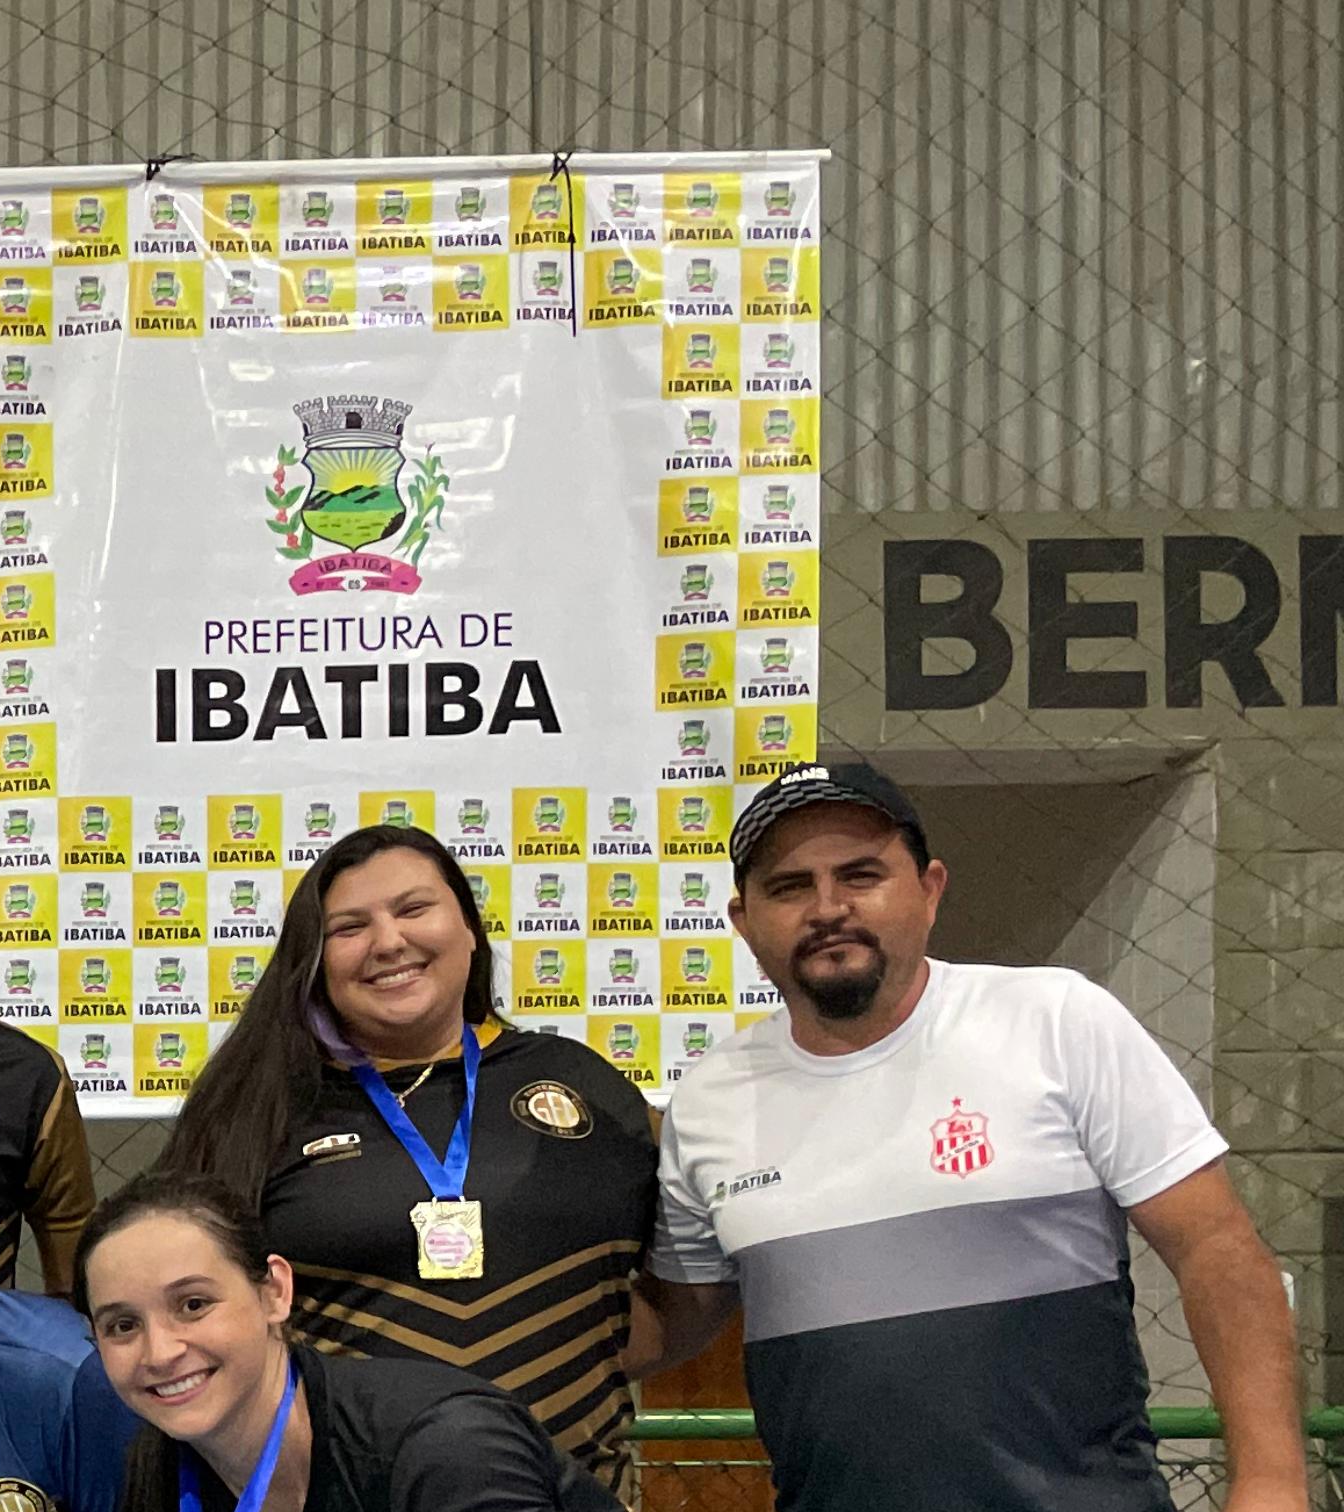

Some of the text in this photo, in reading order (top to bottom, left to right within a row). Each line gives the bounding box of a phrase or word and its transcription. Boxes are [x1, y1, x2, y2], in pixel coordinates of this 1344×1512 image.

[437, 232, 503, 249] IBATIBA
[590, 228, 657, 244] IBATIBA
[668, 226, 734, 242] IBATIBA
[746, 226, 812, 241] IBATIBA
[134, 239, 198, 254] IBATIBA
[209, 239, 273, 253] IBATIBA
[284, 237, 350, 252] IBATIBA
[361, 235, 427, 251] IBATIBA
[57, 243, 122, 259] IBATIBA
[438, 309, 504, 325] IBATIBA
[588, 304, 656, 322] IBATIBA
[746, 302, 813, 317] IBATIBA
[58, 317, 123, 338] IBATIBA
[135, 316, 198, 331] IBATIBA
[209, 314, 275, 330] IBATIBA
[285, 313, 350, 328] IBATIBA
[668, 379, 734, 393] IBATIBA
[745, 376, 813, 393] IBATIBA
[665, 455, 733, 472] IBATIBA
[745, 453, 813, 469] IBATIBA
[663, 532, 732, 550] IBATIBA
[744, 529, 813, 545] IBATIBA
[317, 557, 393, 575] IBATIBA
[662, 609, 730, 628] IBATIBA
[743, 605, 813, 623] IBATIBA
[204, 612, 513, 656] PREFEITURA DE
[660, 687, 728, 705] IBATIBA
[740, 682, 811, 700] IBATIBA
[155, 660, 563, 743] IBATIBA
[661, 764, 727, 781] IBATIBA
[447, 845, 506, 858] BATIBA
[517, 842, 581, 857] IBATIBA
[592, 842, 653, 856] IBATIBA
[663, 840, 727, 856] IBATIBA
[64, 851, 127, 865] IBATIBA
[138, 850, 202, 865] IBATIBA
[212, 849, 277, 864] IBATIBA
[517, 918, 581, 933] IBATIBA
[591, 917, 654, 932] IBATIBA
[664, 917, 727, 931] IBATIBA
[63, 927, 127, 942] IBATIBA
[138, 926, 202, 941] IBATIBA
[213, 925, 277, 940] IBATIBA
[517, 994, 581, 1009] IBATIBA
[592, 993, 654, 1008] IBATIBA
[665, 992, 728, 1007] IBATIBA
[64, 1003, 128, 1018] IBATIBA
[138, 1002, 202, 1016] IBATIBA
[72, 1079, 127, 1091] BATIBA
[139, 1078, 191, 1091] IBATIB
[729, 1171, 781, 1194] IBATIBA
